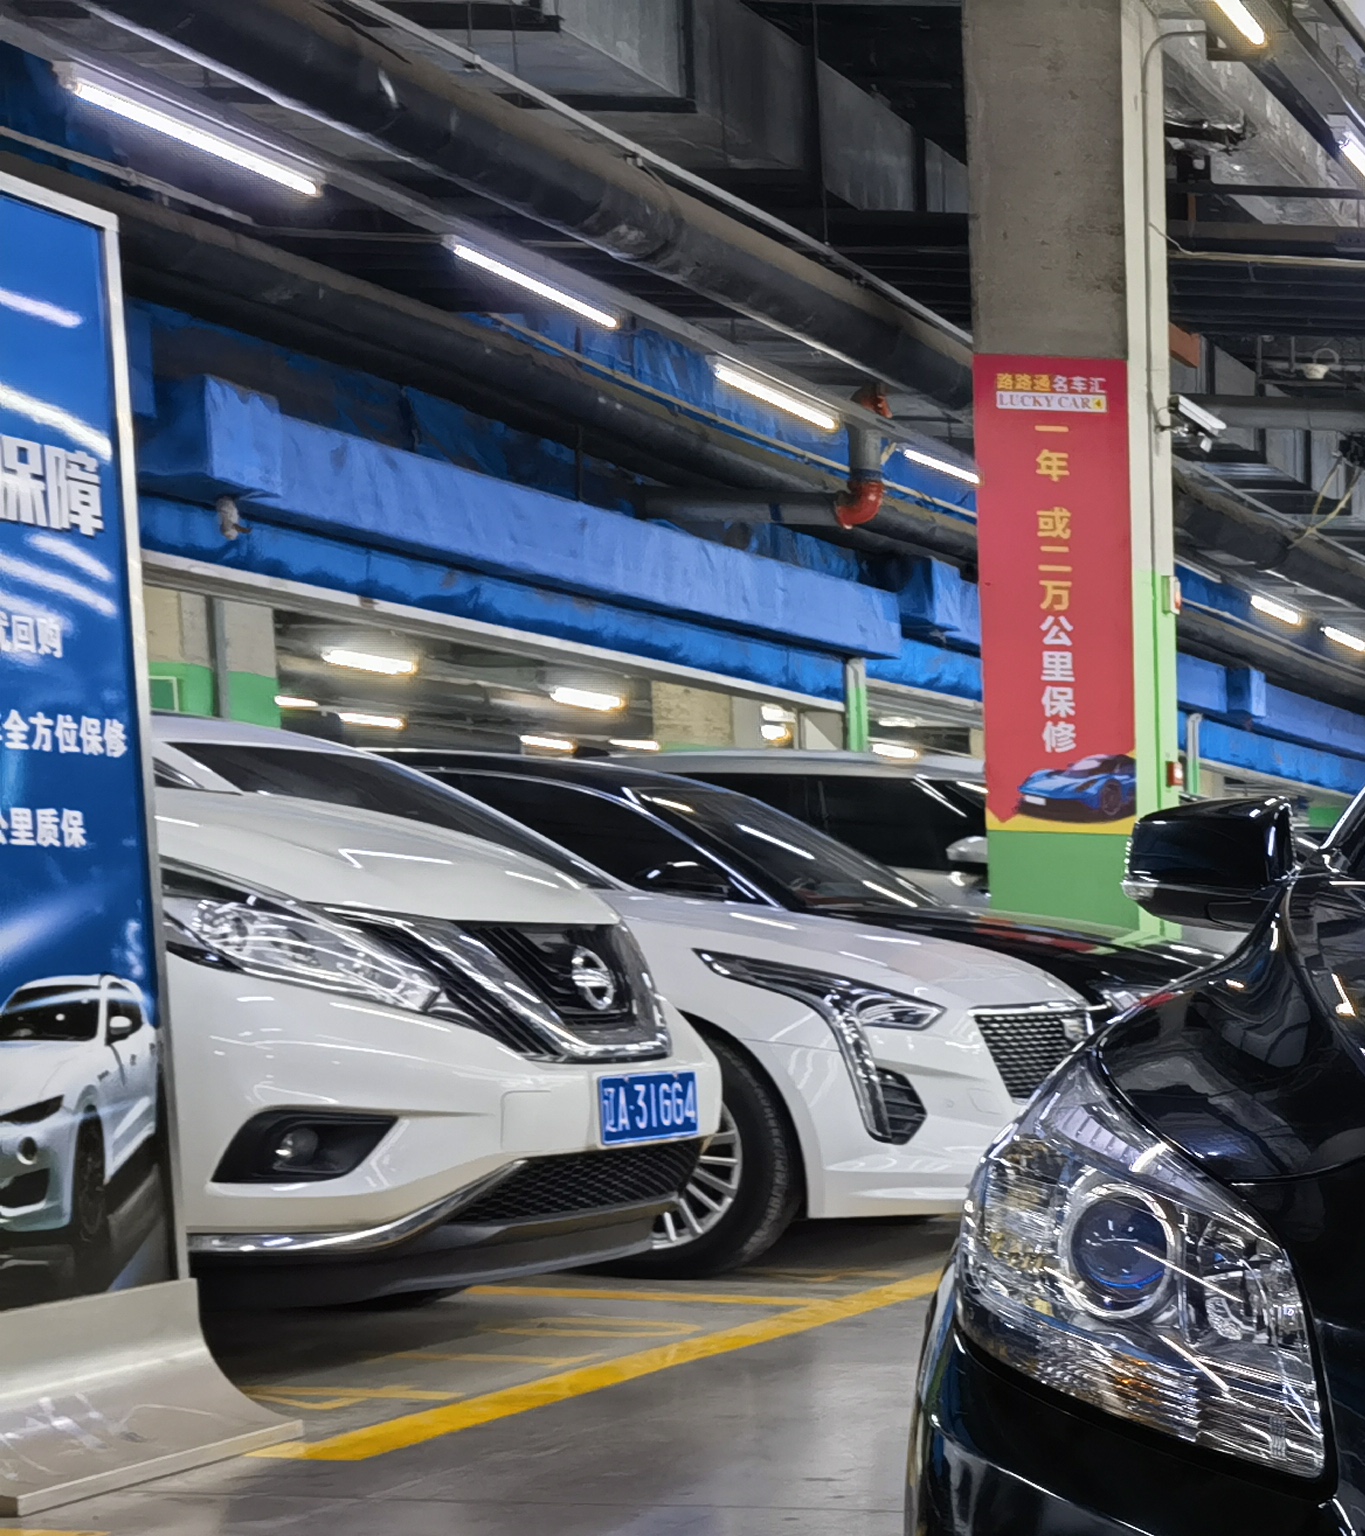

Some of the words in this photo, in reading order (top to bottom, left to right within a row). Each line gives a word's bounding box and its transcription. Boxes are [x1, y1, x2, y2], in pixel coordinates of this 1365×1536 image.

[1000, 394, 1053, 408] LUCKY
[1058, 396, 1092, 409] CAR
[0, 709, 127, 758] 全方位保修
